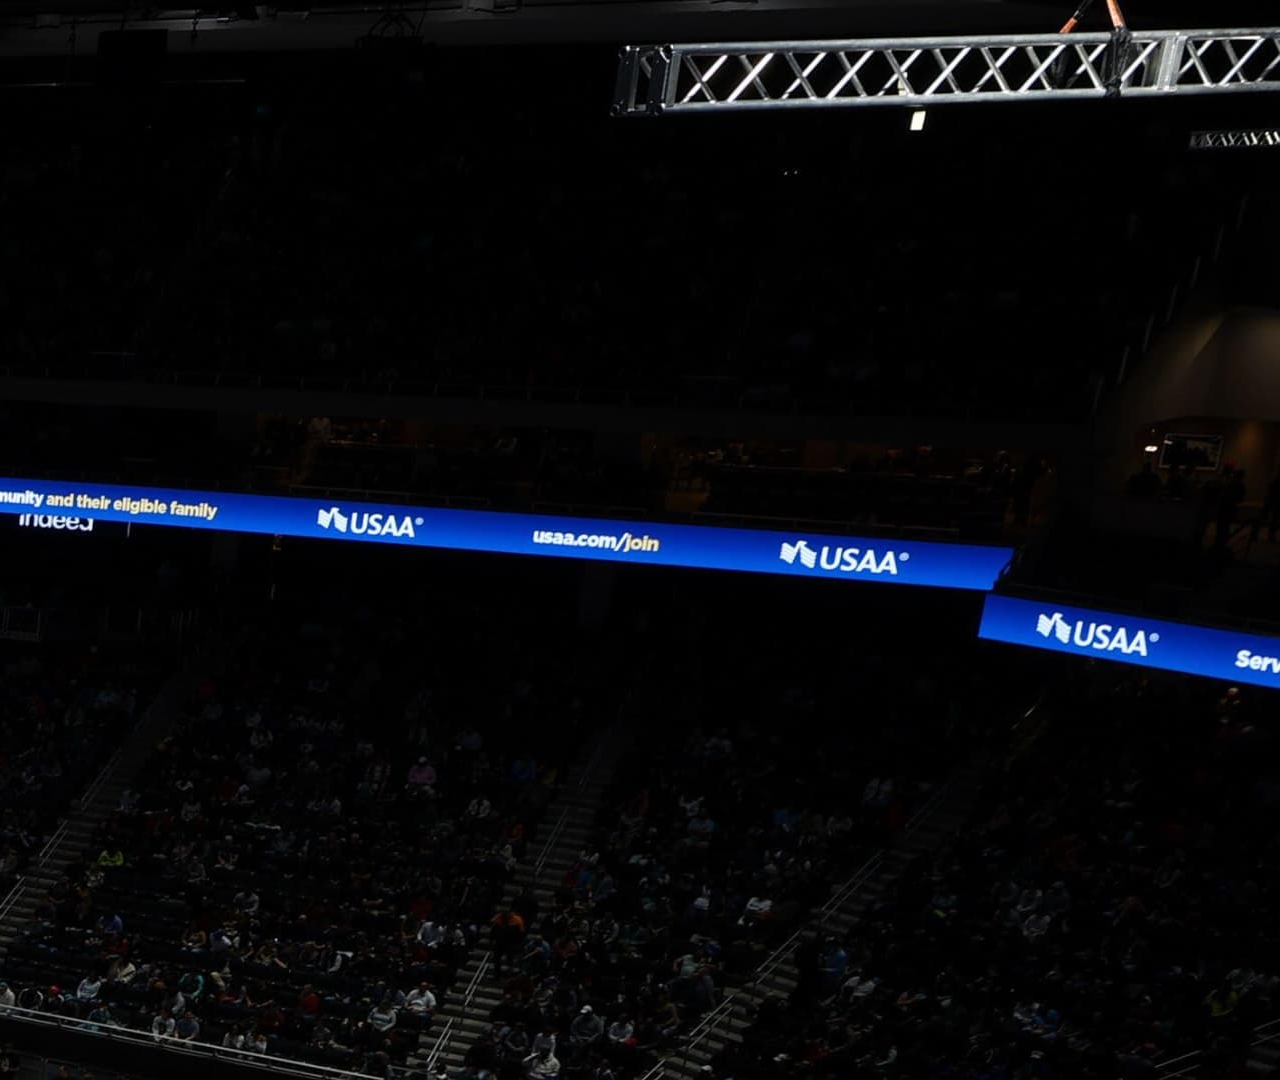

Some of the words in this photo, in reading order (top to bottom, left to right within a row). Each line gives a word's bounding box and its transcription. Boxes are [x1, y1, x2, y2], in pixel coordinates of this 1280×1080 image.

[46, 491, 74, 507] and
[76, 493, 111, 510] their
[113, 495, 167, 517] eligible
[169, 500, 217, 520] family
[350, 513, 414, 538] USAA
[533, 529, 659, 553] usaa.com/join
[820, 547, 898, 575] USAA
[1074, 621, 1147, 656] USAA
[1235, 650, 1280, 673] Serv
